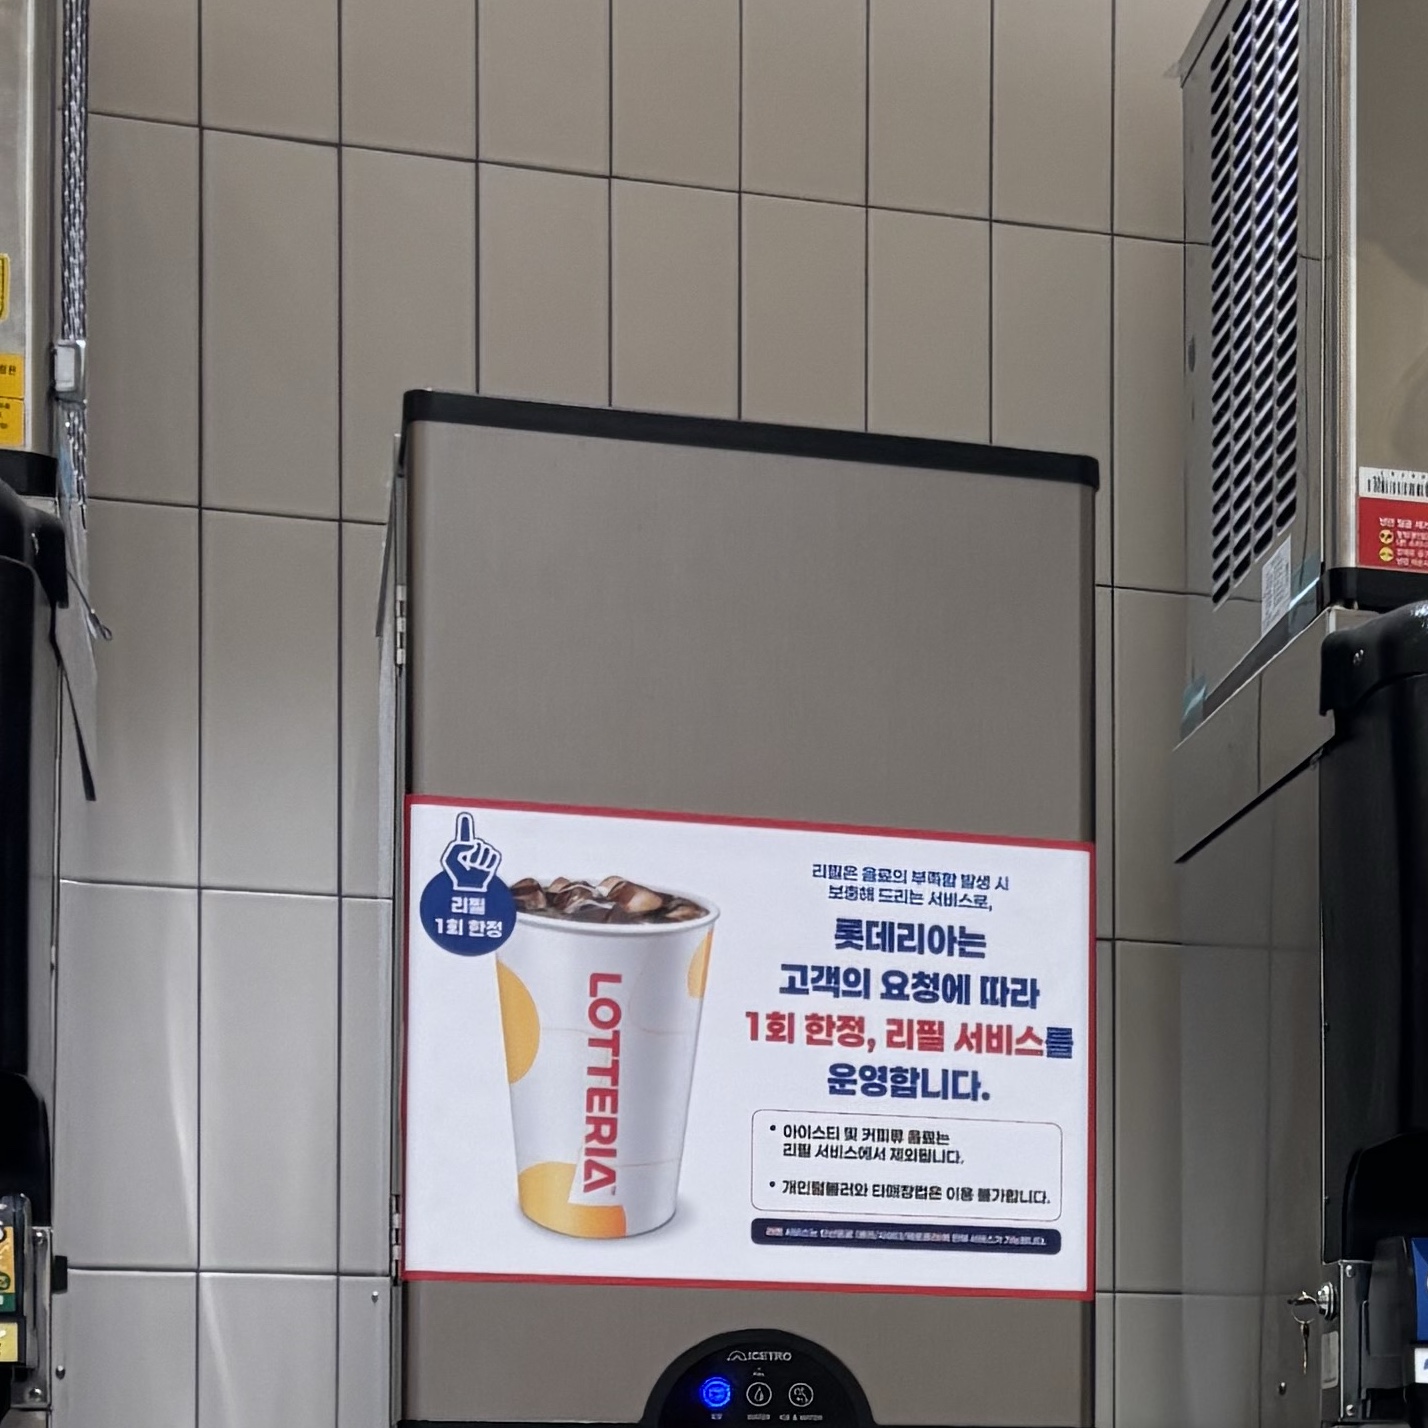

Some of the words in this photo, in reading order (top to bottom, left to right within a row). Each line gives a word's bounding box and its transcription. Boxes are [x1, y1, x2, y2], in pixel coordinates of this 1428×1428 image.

[812, 863, 858, 882] 리필은
[960, 873, 991, 891] 발생
[994, 875, 1010, 891] 시
[451, 896, 486, 916] 리필
[878, 888, 924, 906] 드리는
[928, 891, 993, 912] 서비스로,
[435, 918, 464, 936] 1회
[468, 919, 503, 938] 한정
[834, 917, 987, 959] 롯데리아는
[779, 963, 871, 1000] 고객의
[880, 969, 971, 1006] 요청에
[980, 975, 1040, 1009] 따라
[745, 1011, 795, 1045] 1회
[804, 1012, 876, 1053] 한정,
[885, 1017, 945, 1053] 리필
[954, 1022, 1074, 1060] 서비스를
[583, 972, 623, 1194] LOTTERIA
[827, 1062, 991, 1102] 운영합니다.
[783, 1124, 840, 1141] 아이스티
[782, 1143, 811, 1158] 리필
[814, 1144, 886, 1161] 서비스에서
